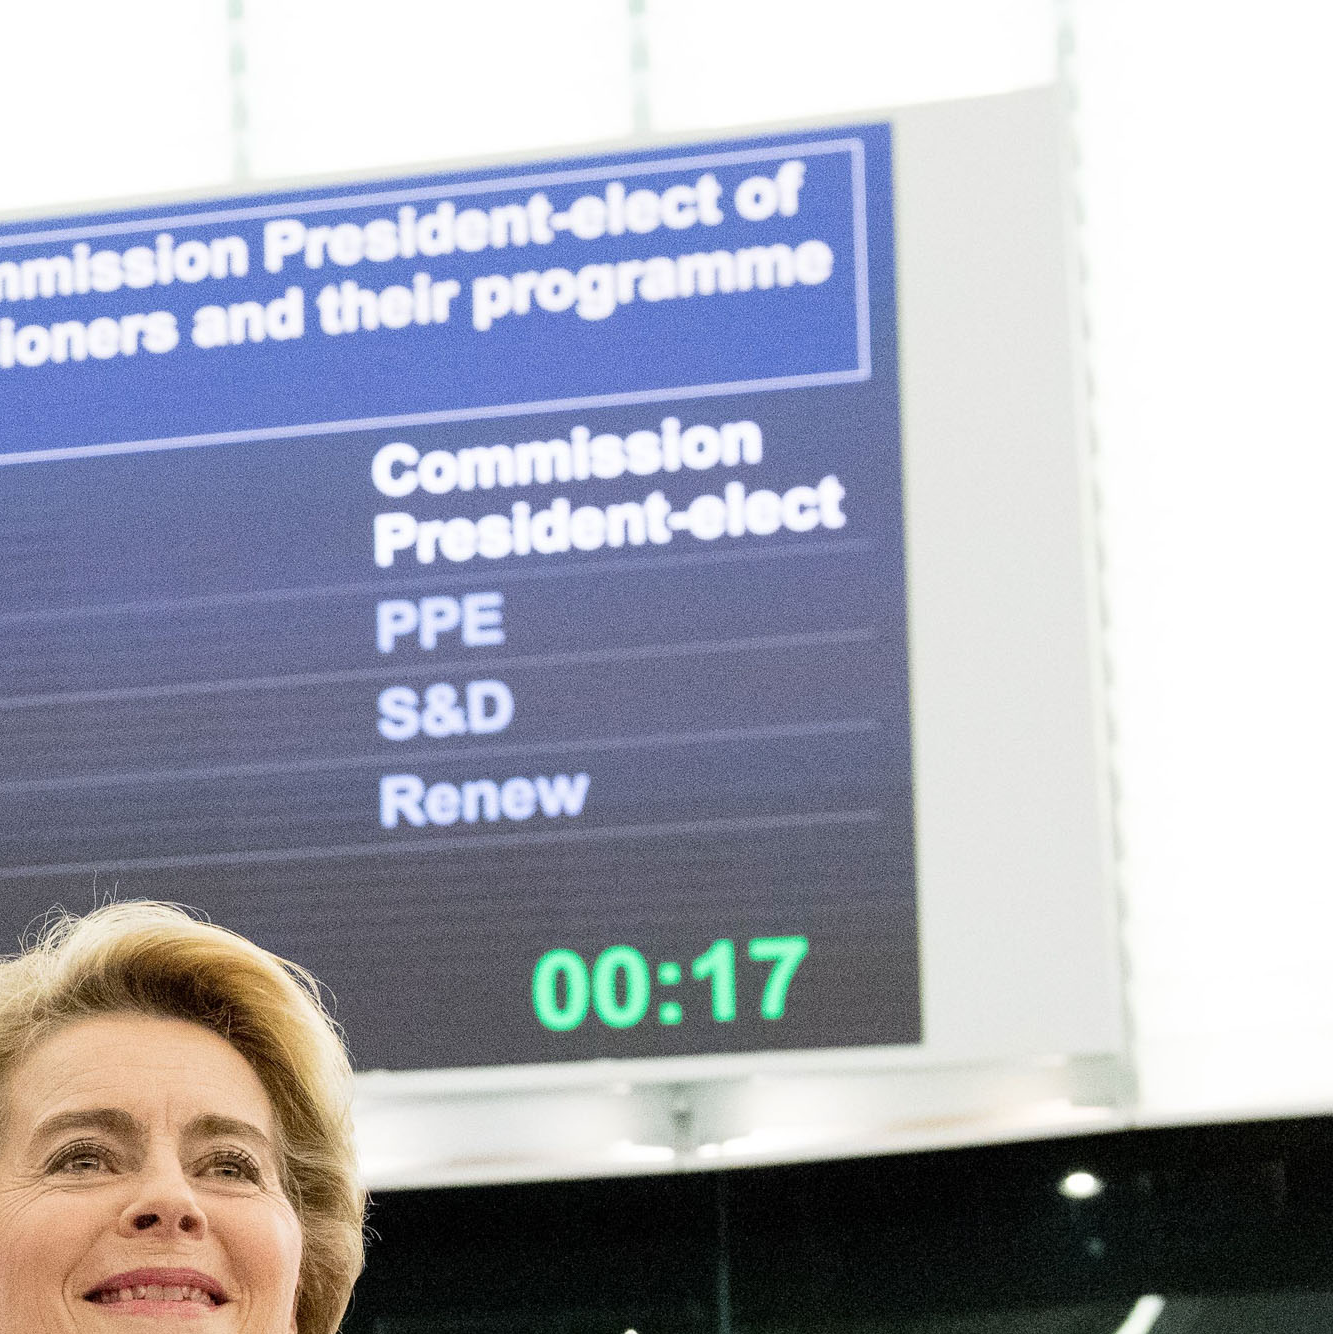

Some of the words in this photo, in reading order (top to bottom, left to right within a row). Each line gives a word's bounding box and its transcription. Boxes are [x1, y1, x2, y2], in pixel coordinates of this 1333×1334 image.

[263, 171, 724, 274] President-elect
[734, 159, 806, 221] of
[191, 286, 305, 349] and
[316, 272, 461, 336] their
[472, 239, 834, 331] programme
[369, 415, 764, 498] Commission
[371, 473, 847, 568] President-elect
[377, 592, 504, 653] PPE
[378, 680, 514, 740] S&D
[380, 774, 590, 828] Renew
[532, 935, 809, 1032] 00:17
